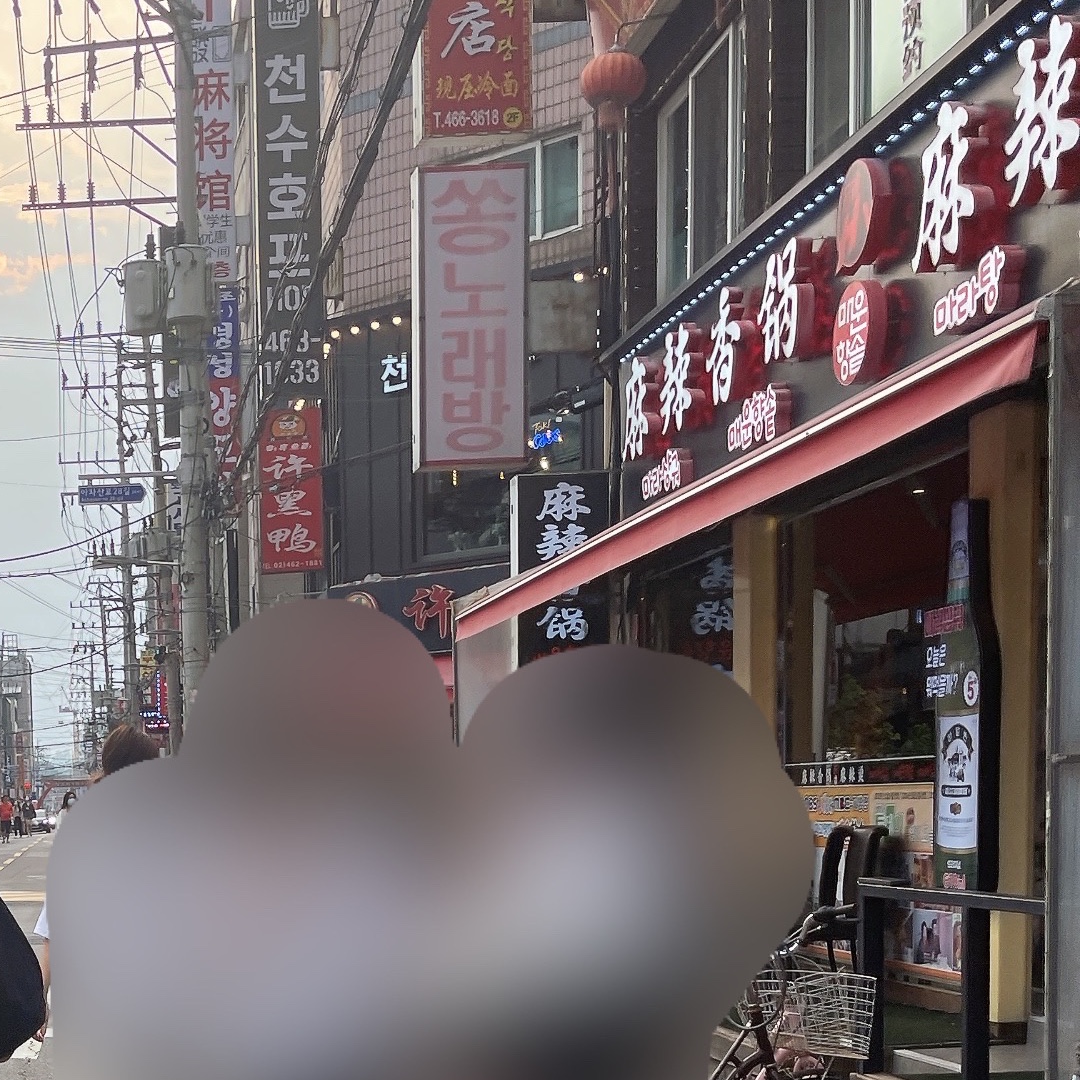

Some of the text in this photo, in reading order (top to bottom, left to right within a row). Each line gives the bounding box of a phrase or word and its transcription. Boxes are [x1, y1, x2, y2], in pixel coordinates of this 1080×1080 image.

[440, 1, 496, 59] 店
[433, 108, 520, 129] T.466-3618 2F
[431, 178, 518, 453] 쏭노래방
[622, 237, 798, 462] 麻辣香锅
[933, 245, 1006, 336] 마라탕
[536, 482, 591, 640] 麻辣锅
